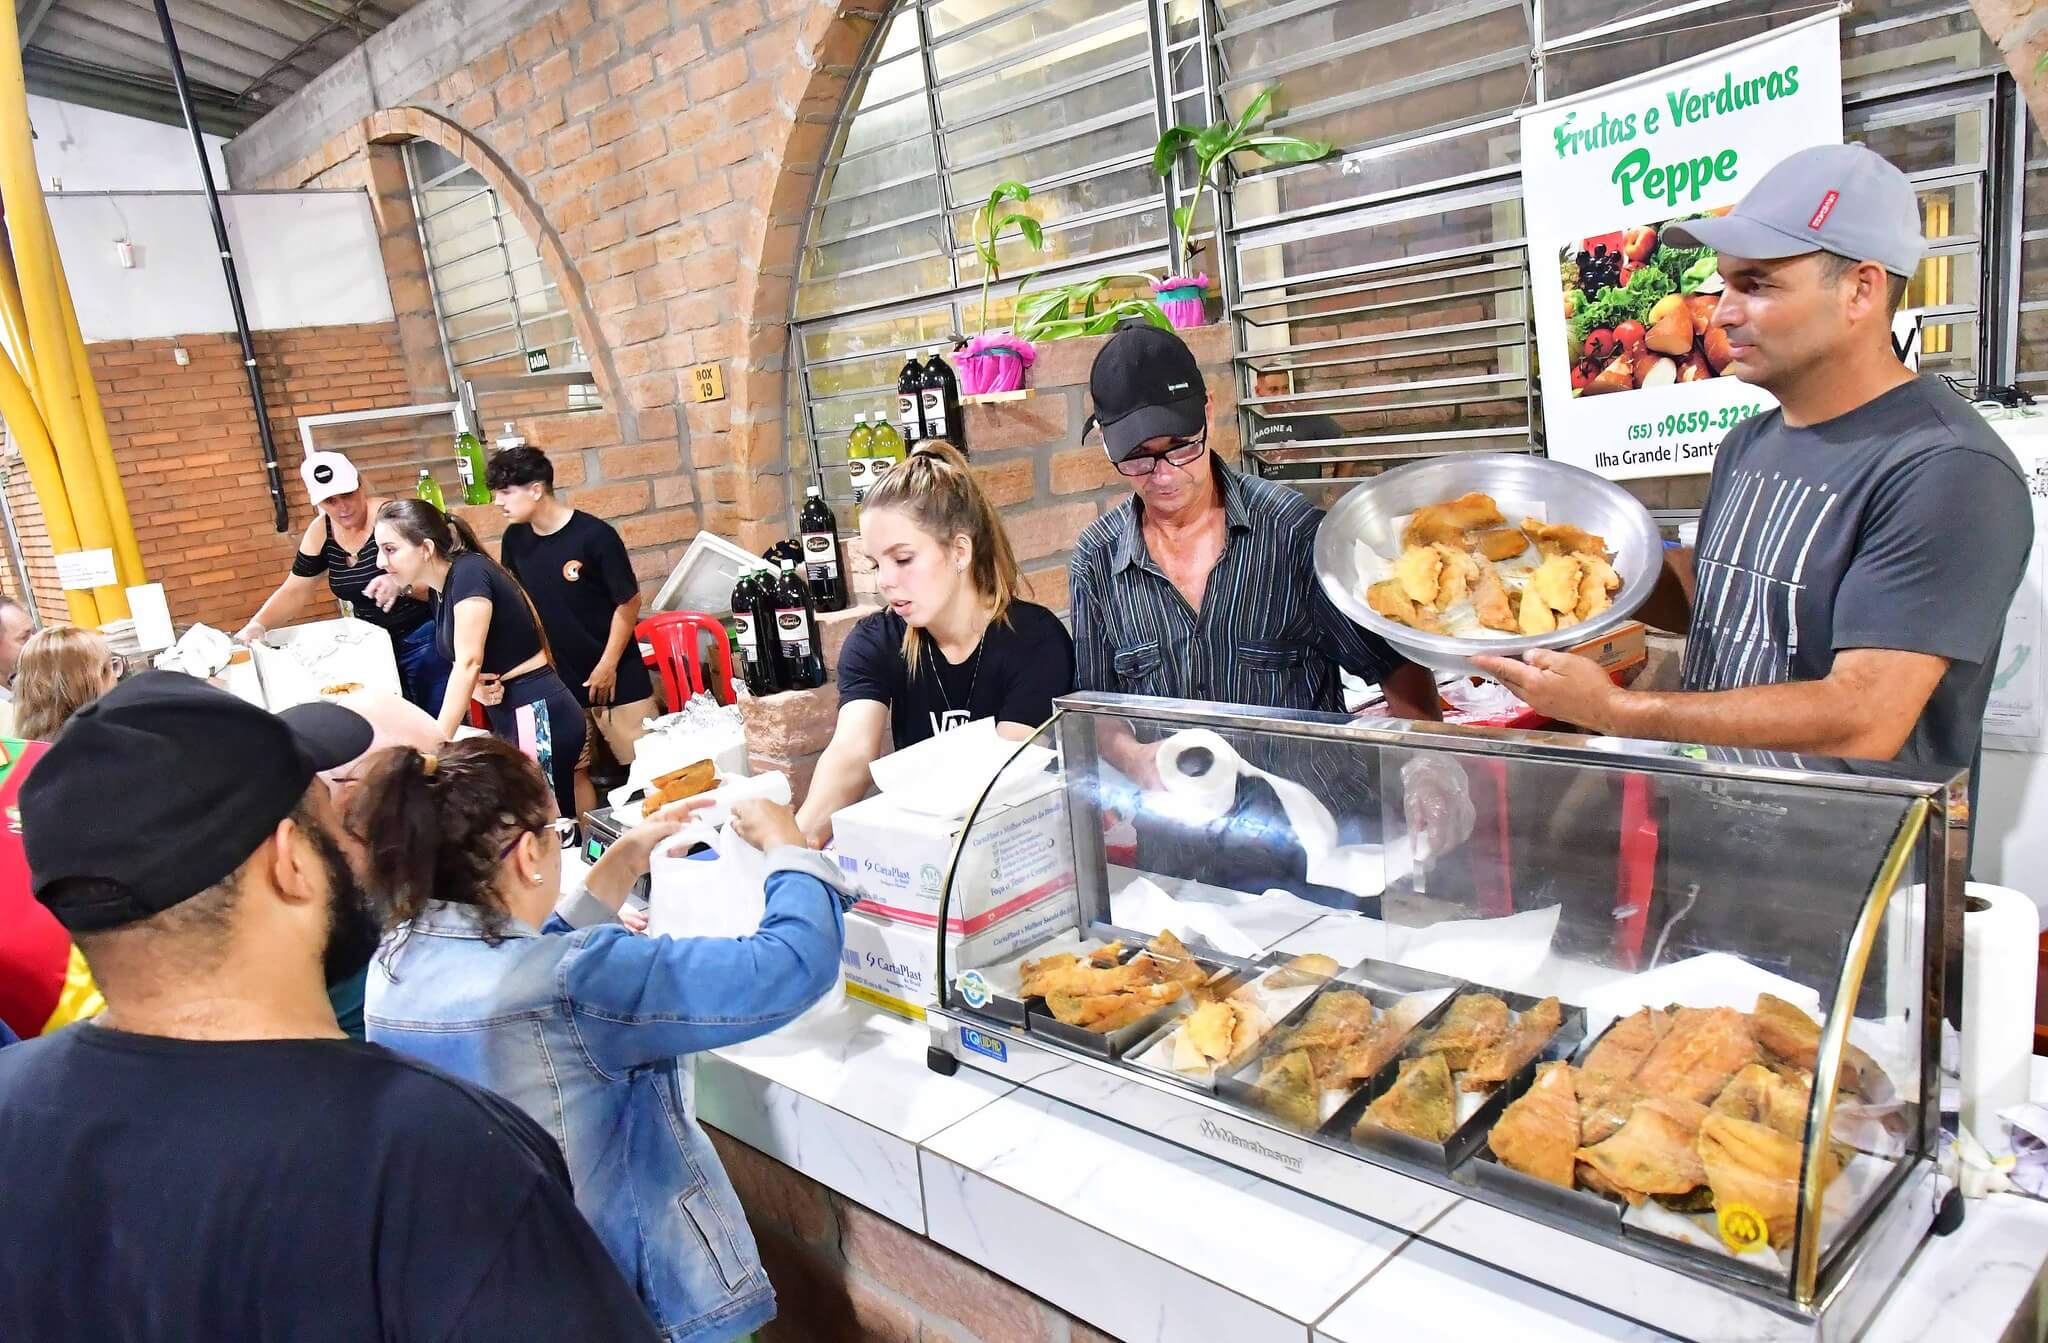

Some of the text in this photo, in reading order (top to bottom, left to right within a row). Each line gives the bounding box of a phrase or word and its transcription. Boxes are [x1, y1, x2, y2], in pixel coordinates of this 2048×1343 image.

[1554, 65, 1799, 159] Frutas e Verduras
[1611, 148, 1738, 207] Peppe
[530, 353, 548, 369] SAÍDA
[701, 382, 712, 397] 19
[1628, 423, 1652, 440] (55)
[1595, 452, 1619, 468] Ilha
[1622, 446, 1671, 465] Grande
[877, 957, 922, 982] CartaPlast
